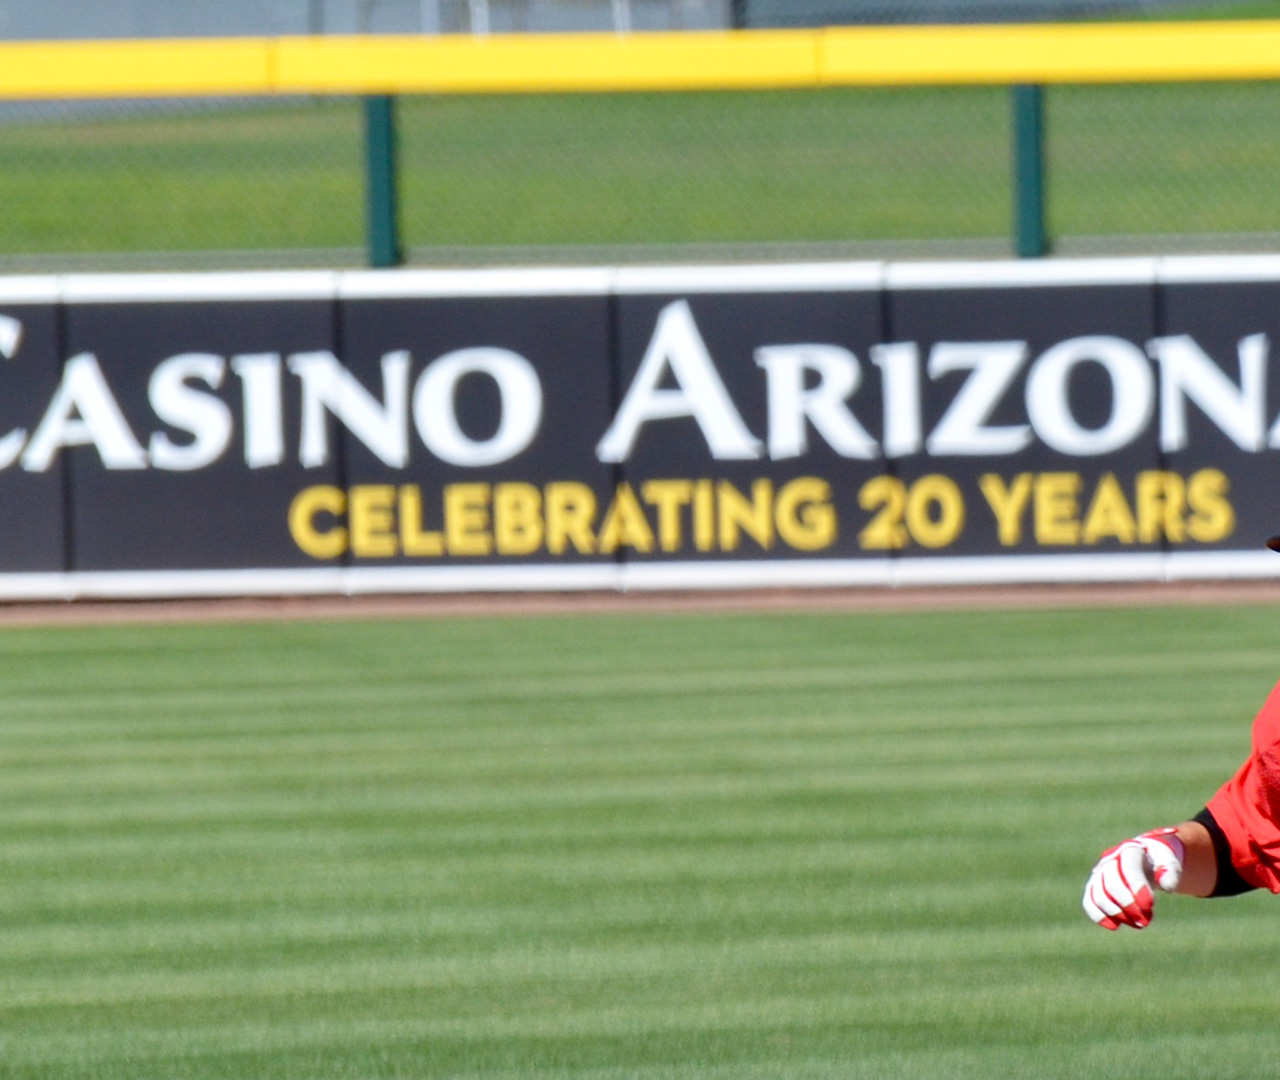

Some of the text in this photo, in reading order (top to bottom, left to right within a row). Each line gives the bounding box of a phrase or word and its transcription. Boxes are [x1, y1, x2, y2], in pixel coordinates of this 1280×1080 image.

[0, 313, 543, 473] ASINO
[288, 468, 1235, 559] CELEBRATING 20 YEARS
